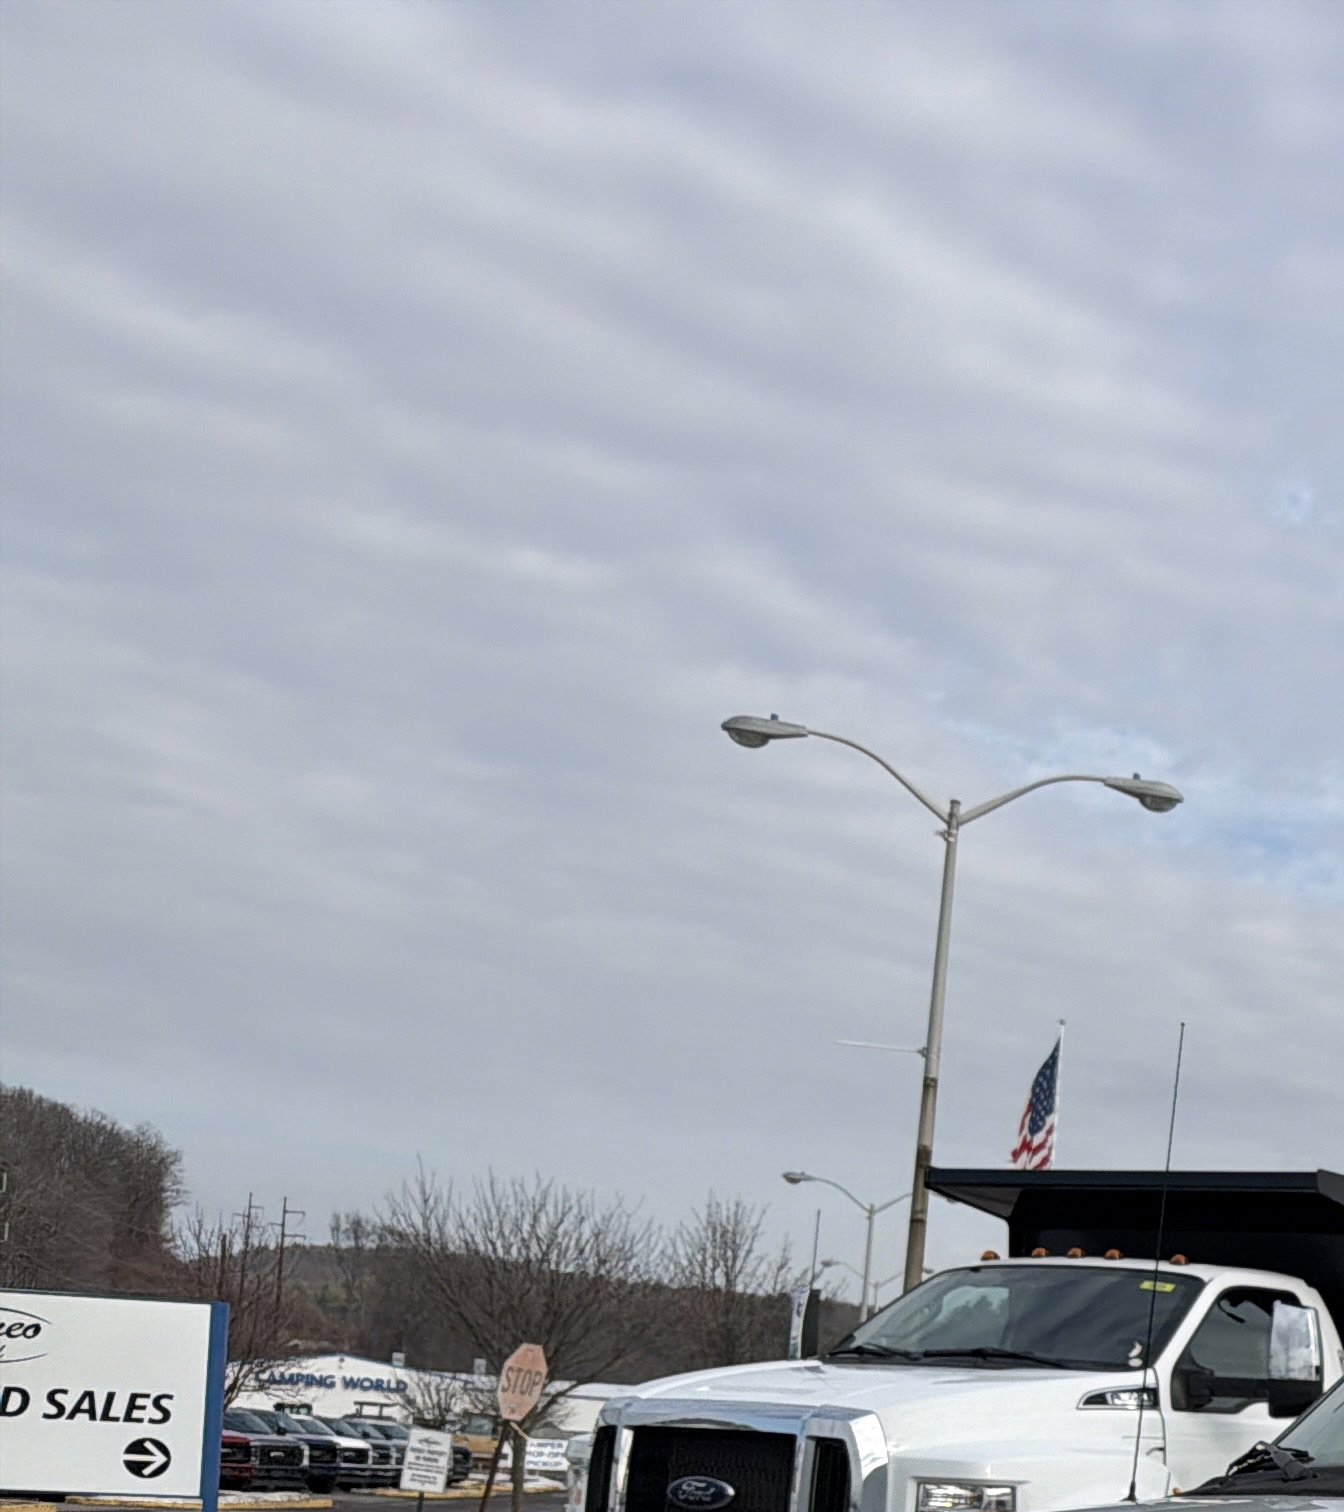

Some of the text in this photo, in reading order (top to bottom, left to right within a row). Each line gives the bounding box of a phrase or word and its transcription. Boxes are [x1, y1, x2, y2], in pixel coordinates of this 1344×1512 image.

[254, 1370, 409, 1393] CAMPING WORLD
[501, 1365, 543, 1397] STOP
[41, 1388, 175, 1425] SALES
